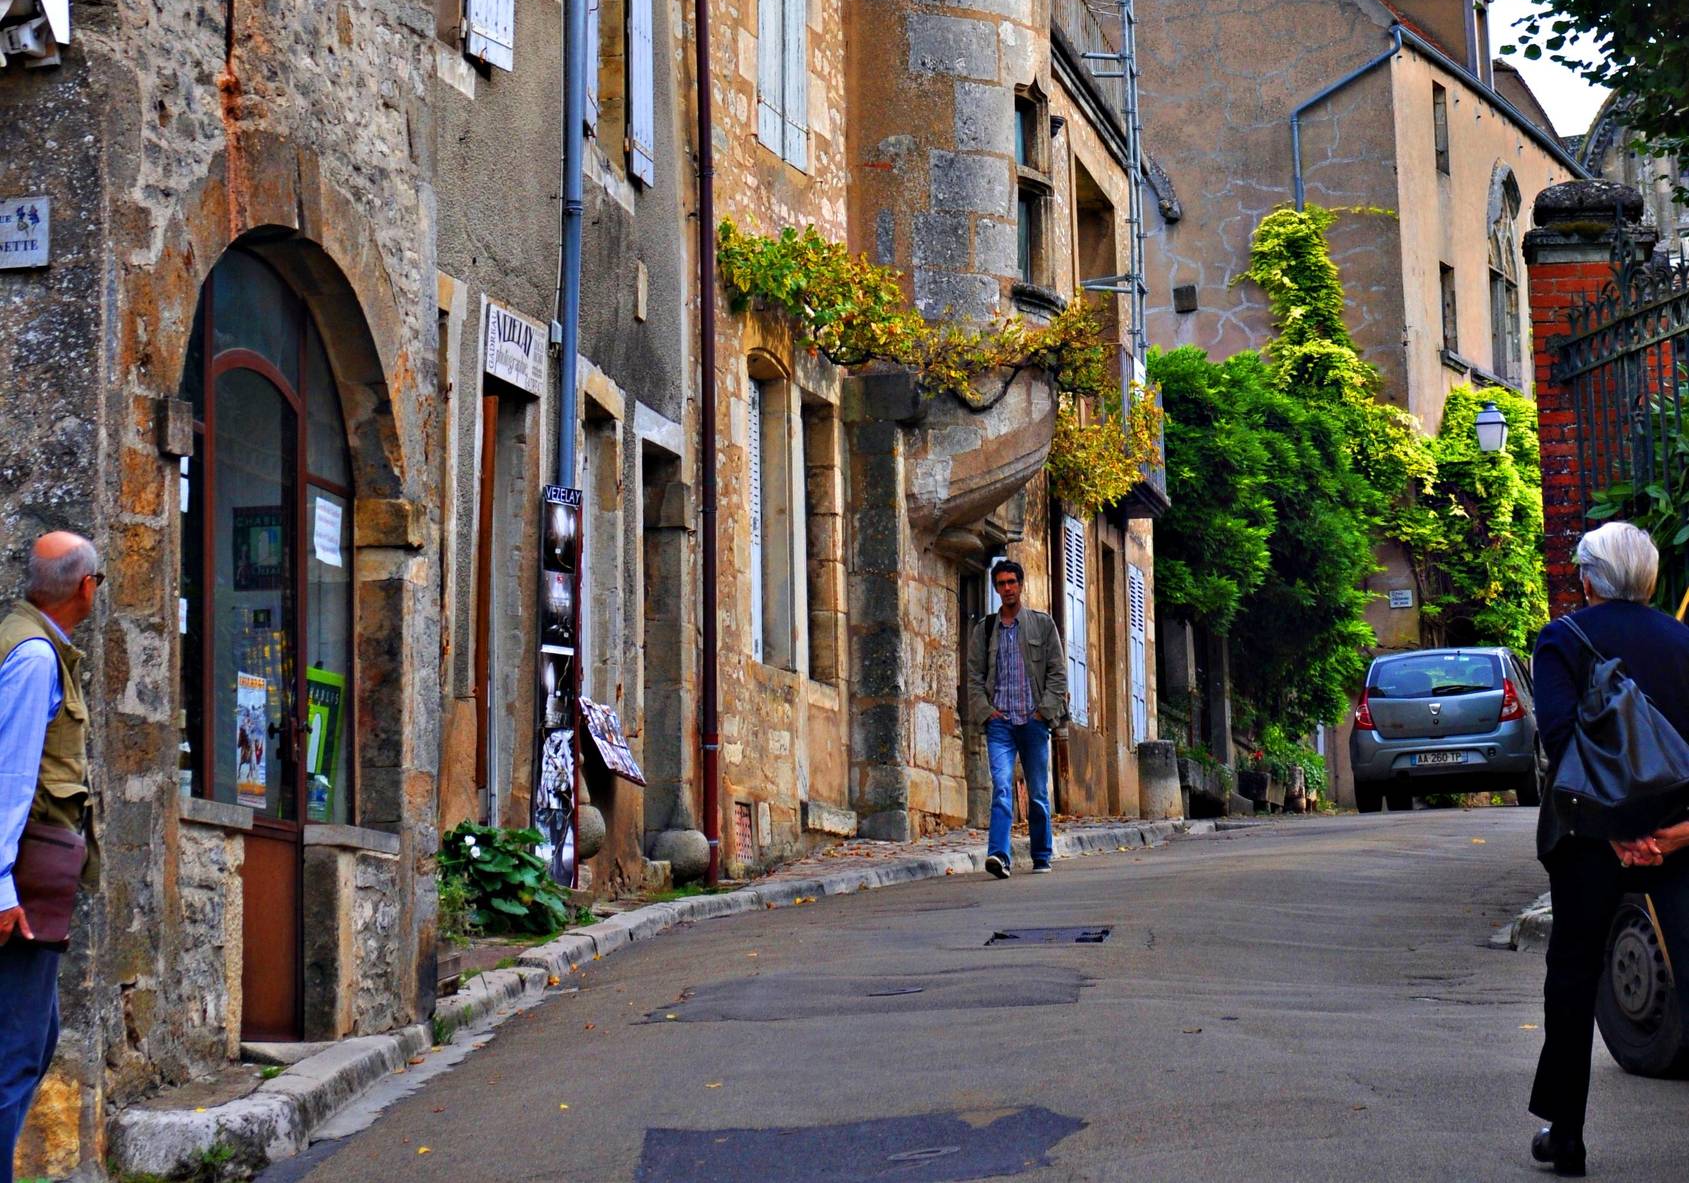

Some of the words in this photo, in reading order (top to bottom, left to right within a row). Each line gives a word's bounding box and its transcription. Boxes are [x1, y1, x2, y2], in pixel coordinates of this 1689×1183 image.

[545, 486, 581, 505] VEZELAY
[1430, 752, 1448, 763] 260
[1451, 752, 1462, 761] TP
